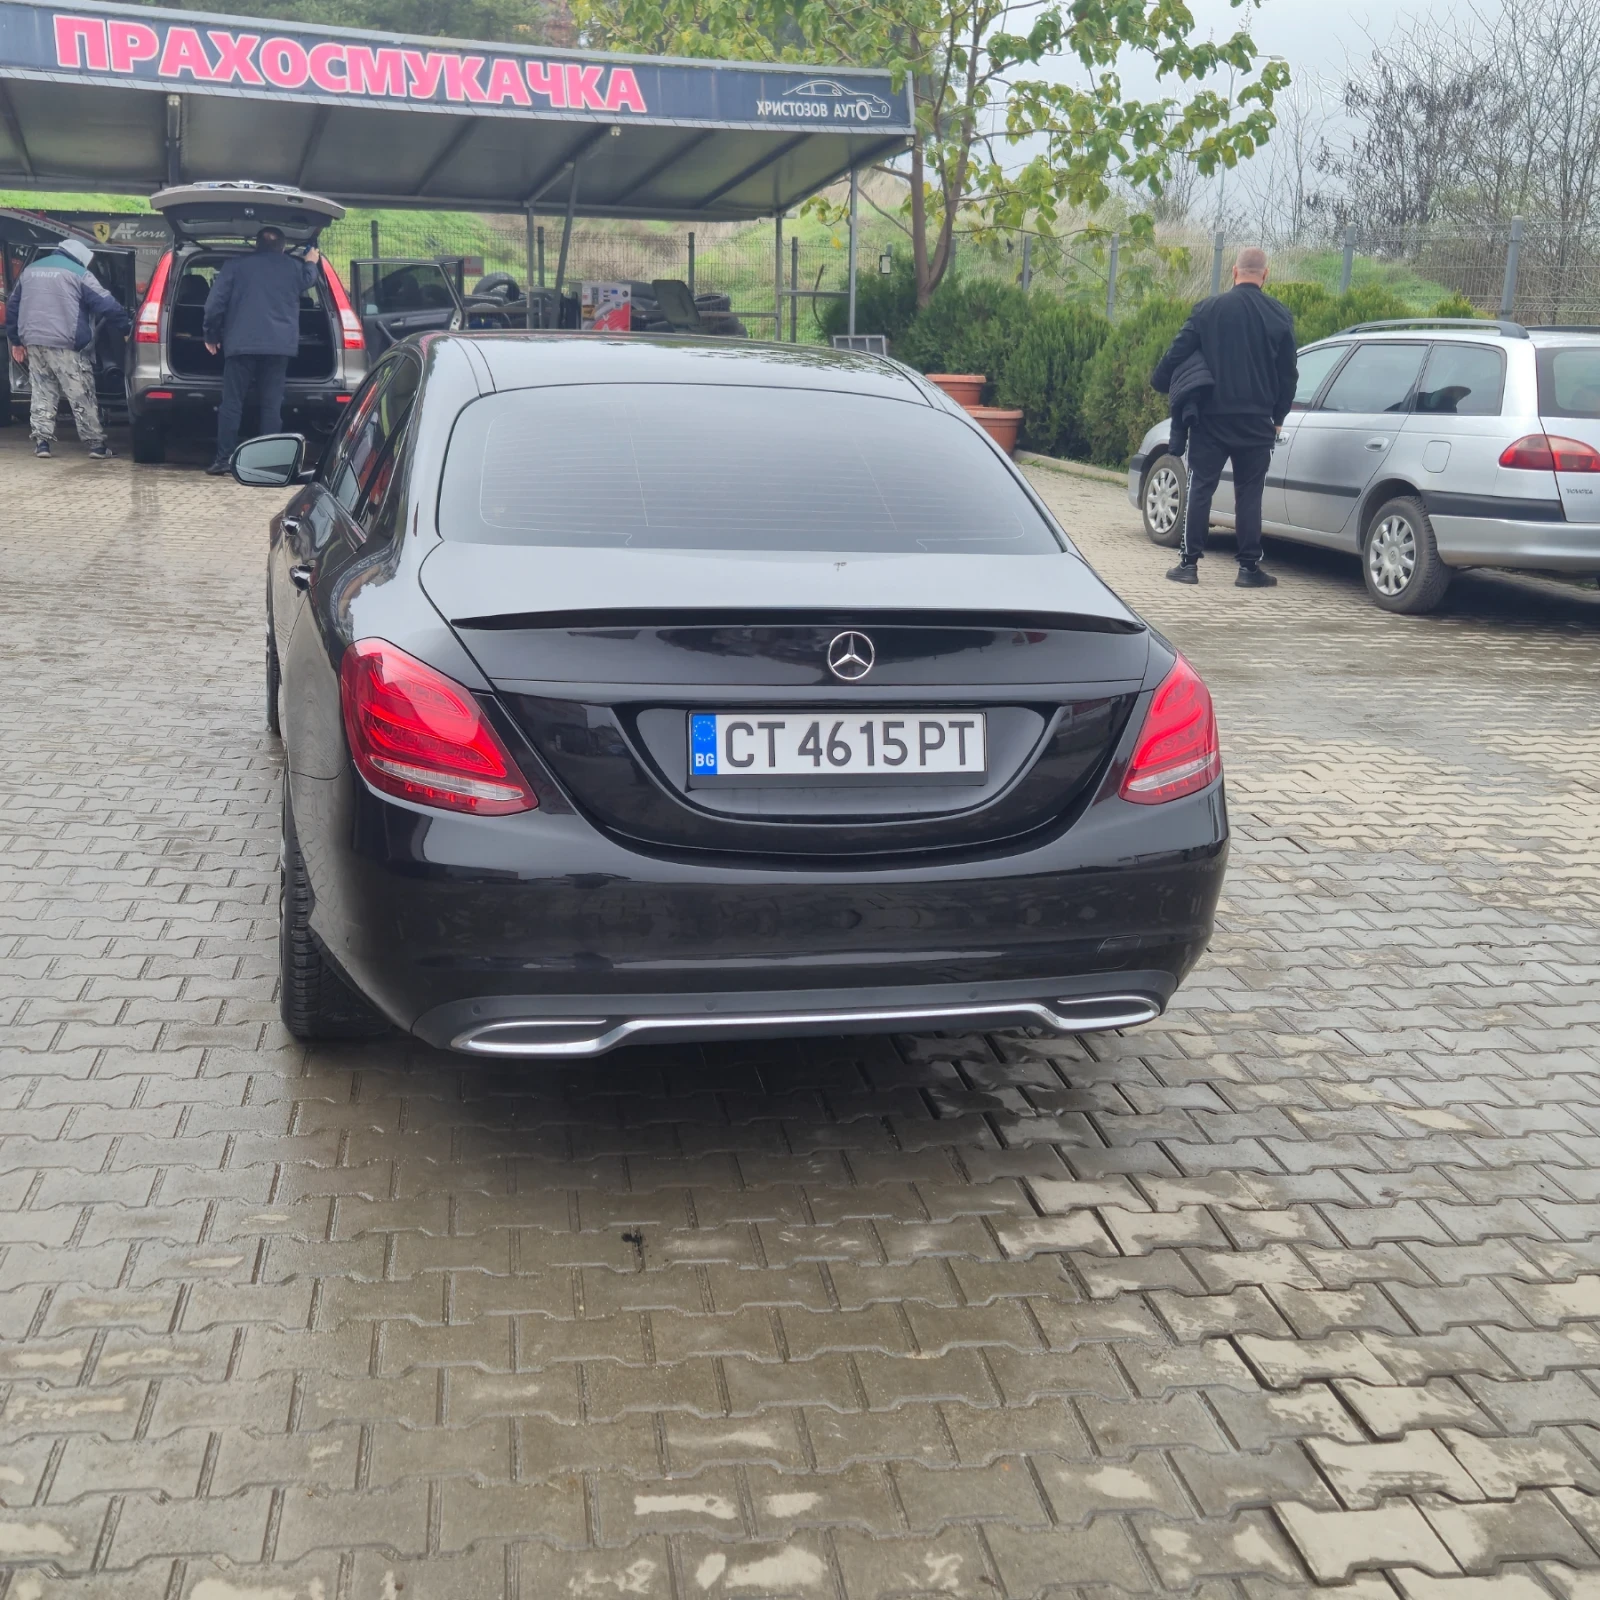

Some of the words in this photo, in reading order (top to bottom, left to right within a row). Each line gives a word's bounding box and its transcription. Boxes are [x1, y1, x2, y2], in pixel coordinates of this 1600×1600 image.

[53, 14, 647, 113] ПРАХОСМУКАЧКА
[756, 100, 828, 118] ХРИСТОЗОВ
[110, 222, 139, 239] AF
[695, 753, 715, 767] BG
